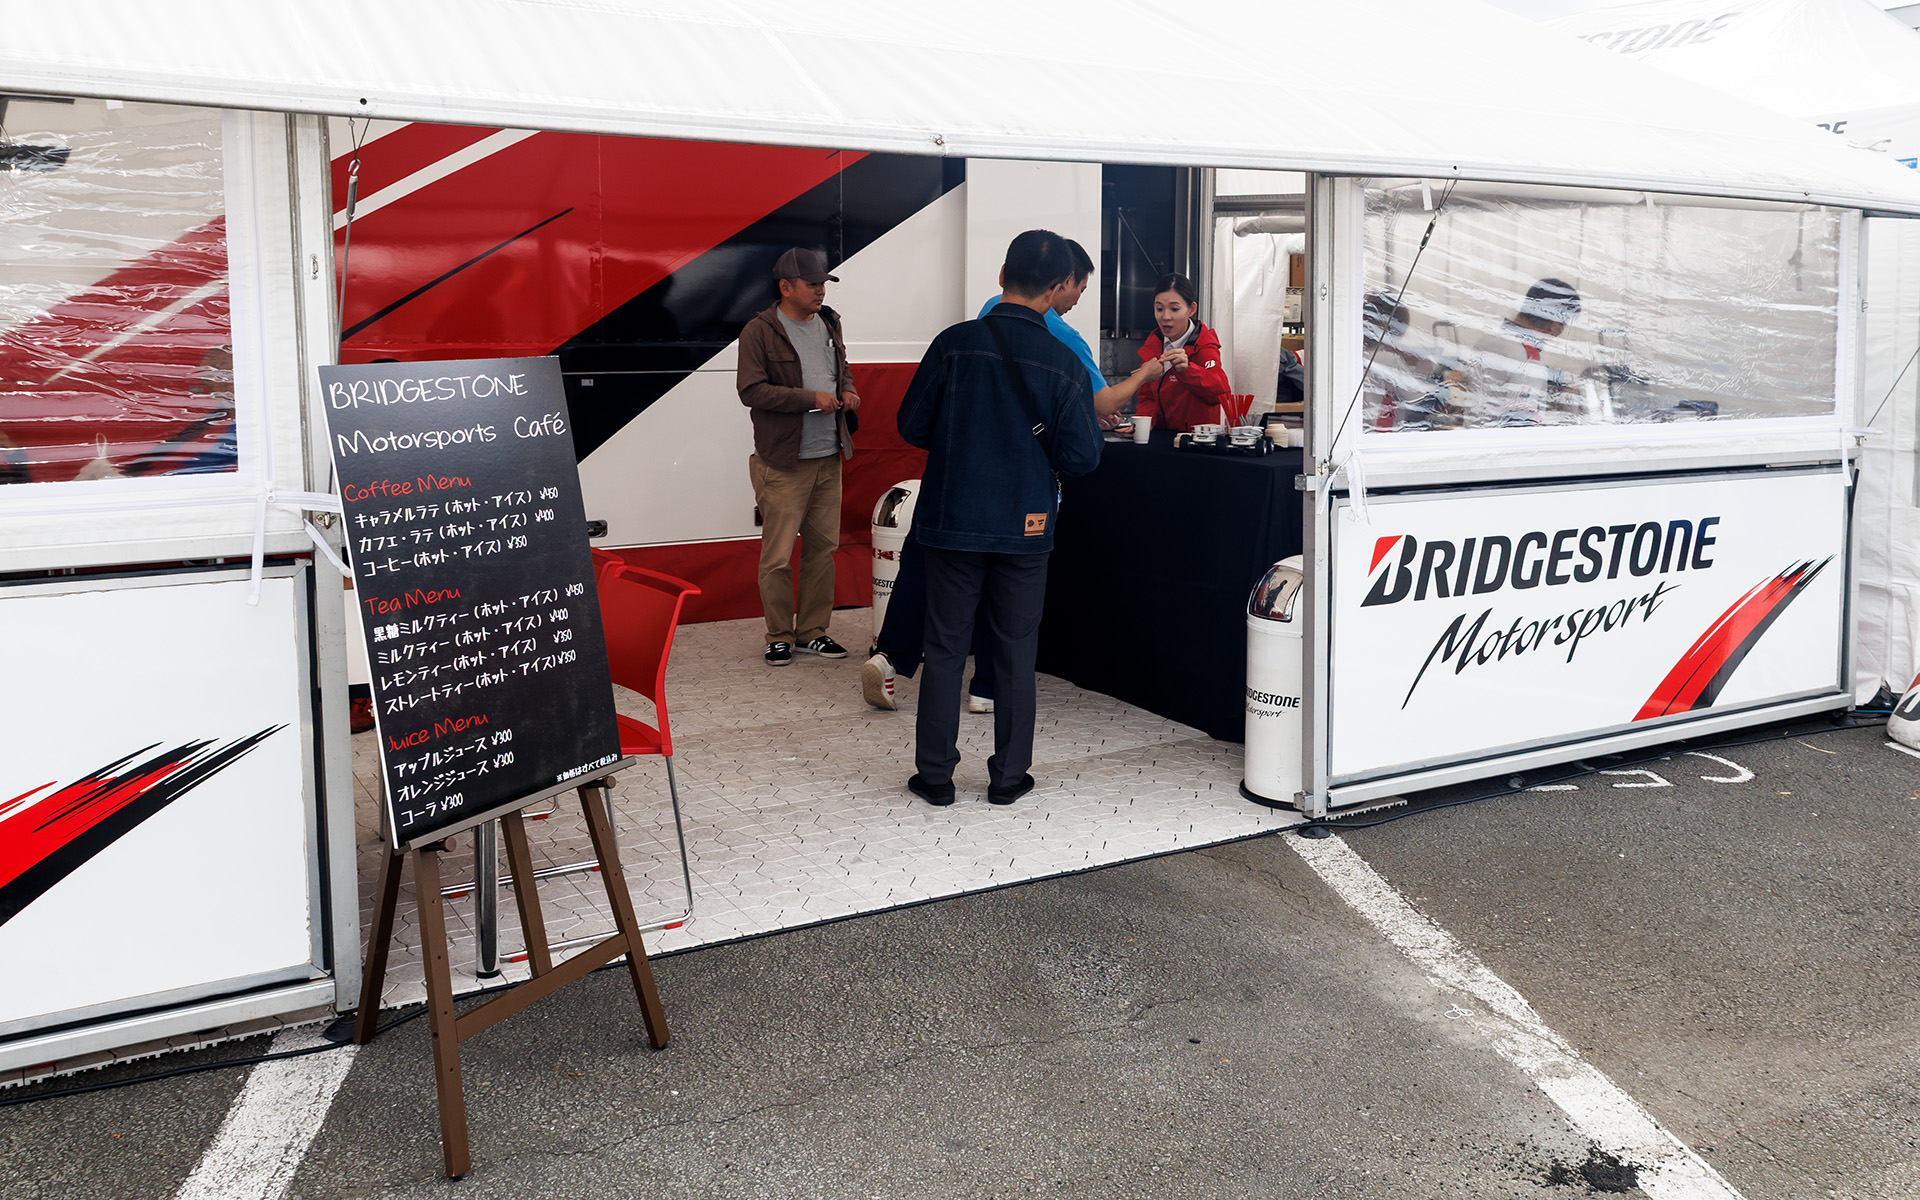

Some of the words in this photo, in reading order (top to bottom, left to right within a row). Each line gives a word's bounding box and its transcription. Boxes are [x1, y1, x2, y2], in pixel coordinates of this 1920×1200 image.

[329, 373, 528, 410] BRIDGESTONE
[337, 423, 497, 457] Motorsports
[514, 412, 567, 440] Café
[344, 479, 414, 502] Coffee
[417, 474, 472, 493] Menu
[539, 486, 559, 500] ¥450
[535, 508, 555, 523] ¥400
[507, 534, 528, 550] ¥350
[1360, 516, 1721, 608] BRIDGESTONE
[365, 596, 402, 616] Tea
[405, 586, 461, 607] Menu
[565, 582, 584, 598] ¥450
[549, 607, 569, 623] ¥400
[553, 628, 573, 644] ¥350
[1401, 580, 1682, 710] Motorsport
[388, 727, 430, 753] Juice
[434, 712, 489, 739] Menu
[394, 737, 487, 778] アップルジュース
[491, 728, 513, 746] ¥300
[397, 760, 489, 802] オレンジジュース
[493, 751, 514, 769] ¥300
[401, 802, 437, 827] コーラ
[440, 792, 464, 811] ¥300
